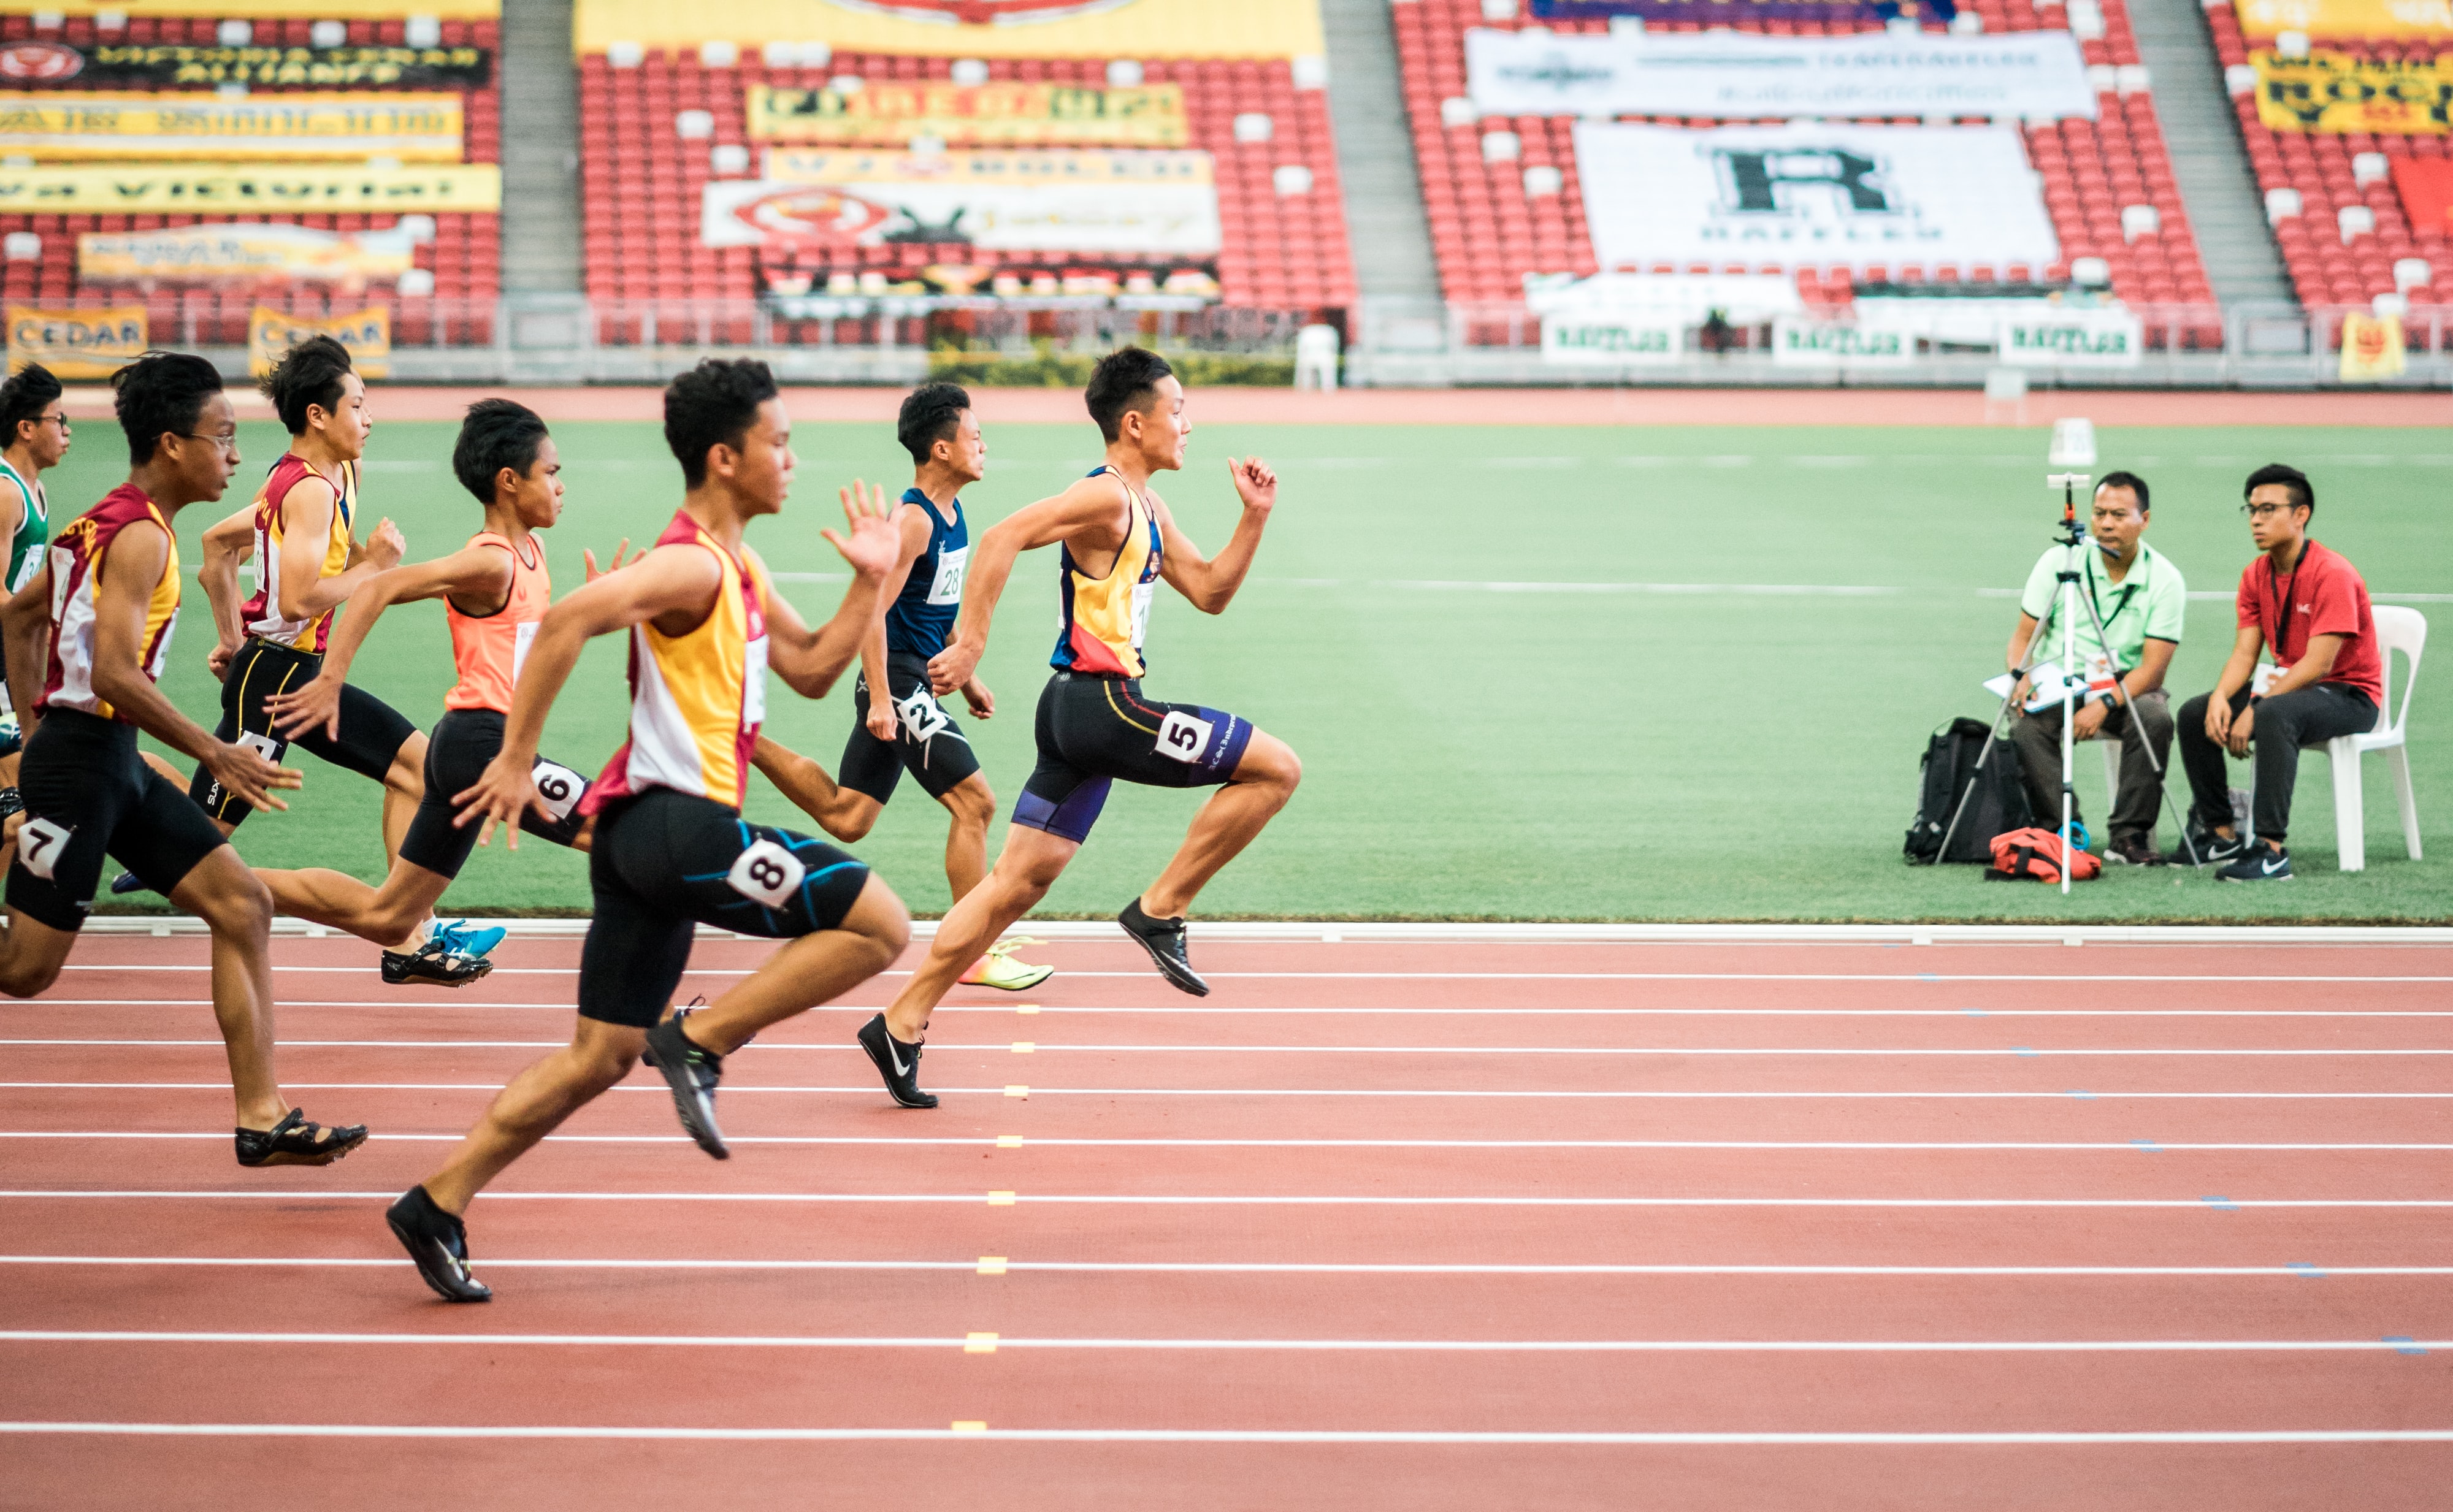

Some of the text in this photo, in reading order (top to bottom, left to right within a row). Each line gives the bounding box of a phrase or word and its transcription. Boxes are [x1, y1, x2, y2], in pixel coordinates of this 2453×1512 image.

[940, 567, 963, 597] 28
[910, 703, 936, 731] 2
[1168, 722, 1198, 751] 5
[538, 774, 570, 801] 6
[28, 827, 54, 861] 7
[749, 856, 785, 890] 8
